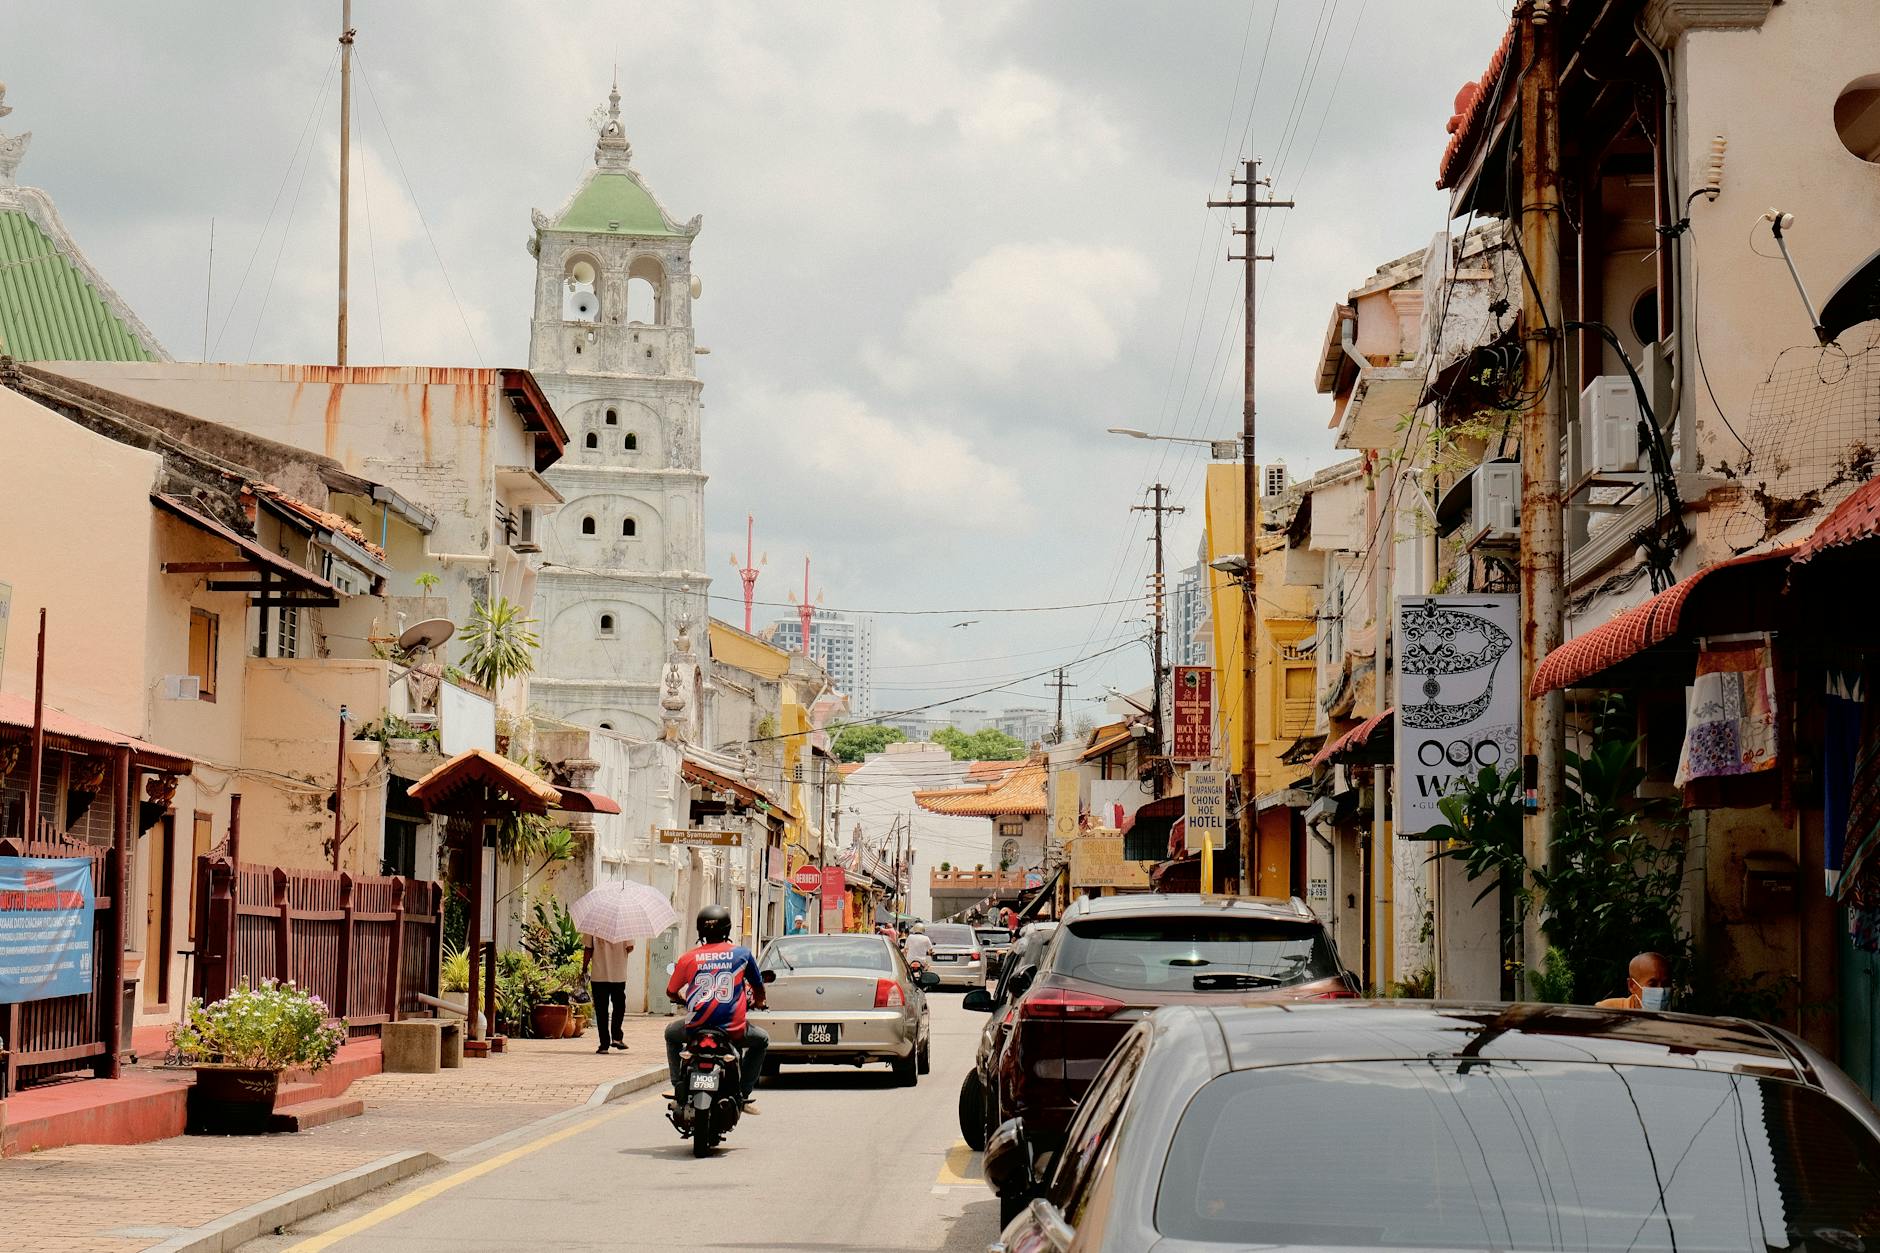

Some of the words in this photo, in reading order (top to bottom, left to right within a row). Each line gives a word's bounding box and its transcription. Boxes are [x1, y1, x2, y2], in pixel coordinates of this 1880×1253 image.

[1176, 725, 1194, 734] HOCK
[1196, 776, 1216, 784] RUMAH
[1189, 786, 1223, 794] TUMPANGAN
[1191, 796, 1220, 805] CHONG
[1198, 806, 1215, 815] HOE
[1189, 816, 1223, 828] HOTEL
[663, 830, 685, 838] Makam
[686, 831, 722, 840] Syamsuddin
[796, 873, 820, 884] BERHENTI
[695, 952, 734, 962] MERCU
[697, 962, 733, 971] RAHMAN
[694, 971, 735, 1004] 39
[811, 1024, 828, 1034] MAY
[807, 1033, 831, 1043] 6268
